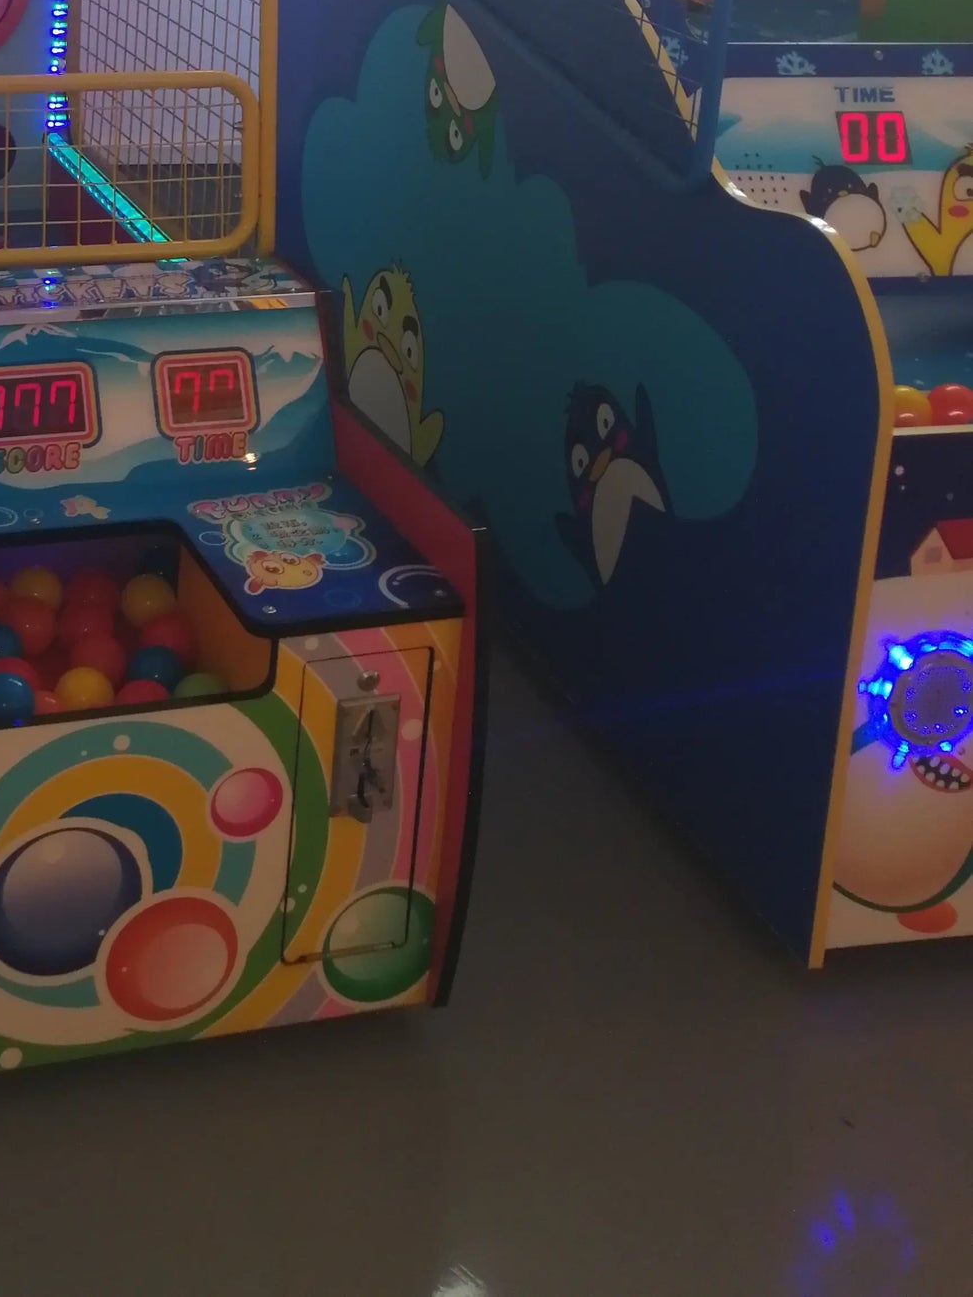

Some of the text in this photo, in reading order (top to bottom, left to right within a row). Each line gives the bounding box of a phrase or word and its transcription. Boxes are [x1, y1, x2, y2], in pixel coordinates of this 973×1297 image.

[834, 86, 896, 104] TIME
[840, 112, 906, 163] 00
[175, 431, 247, 464] TIME
